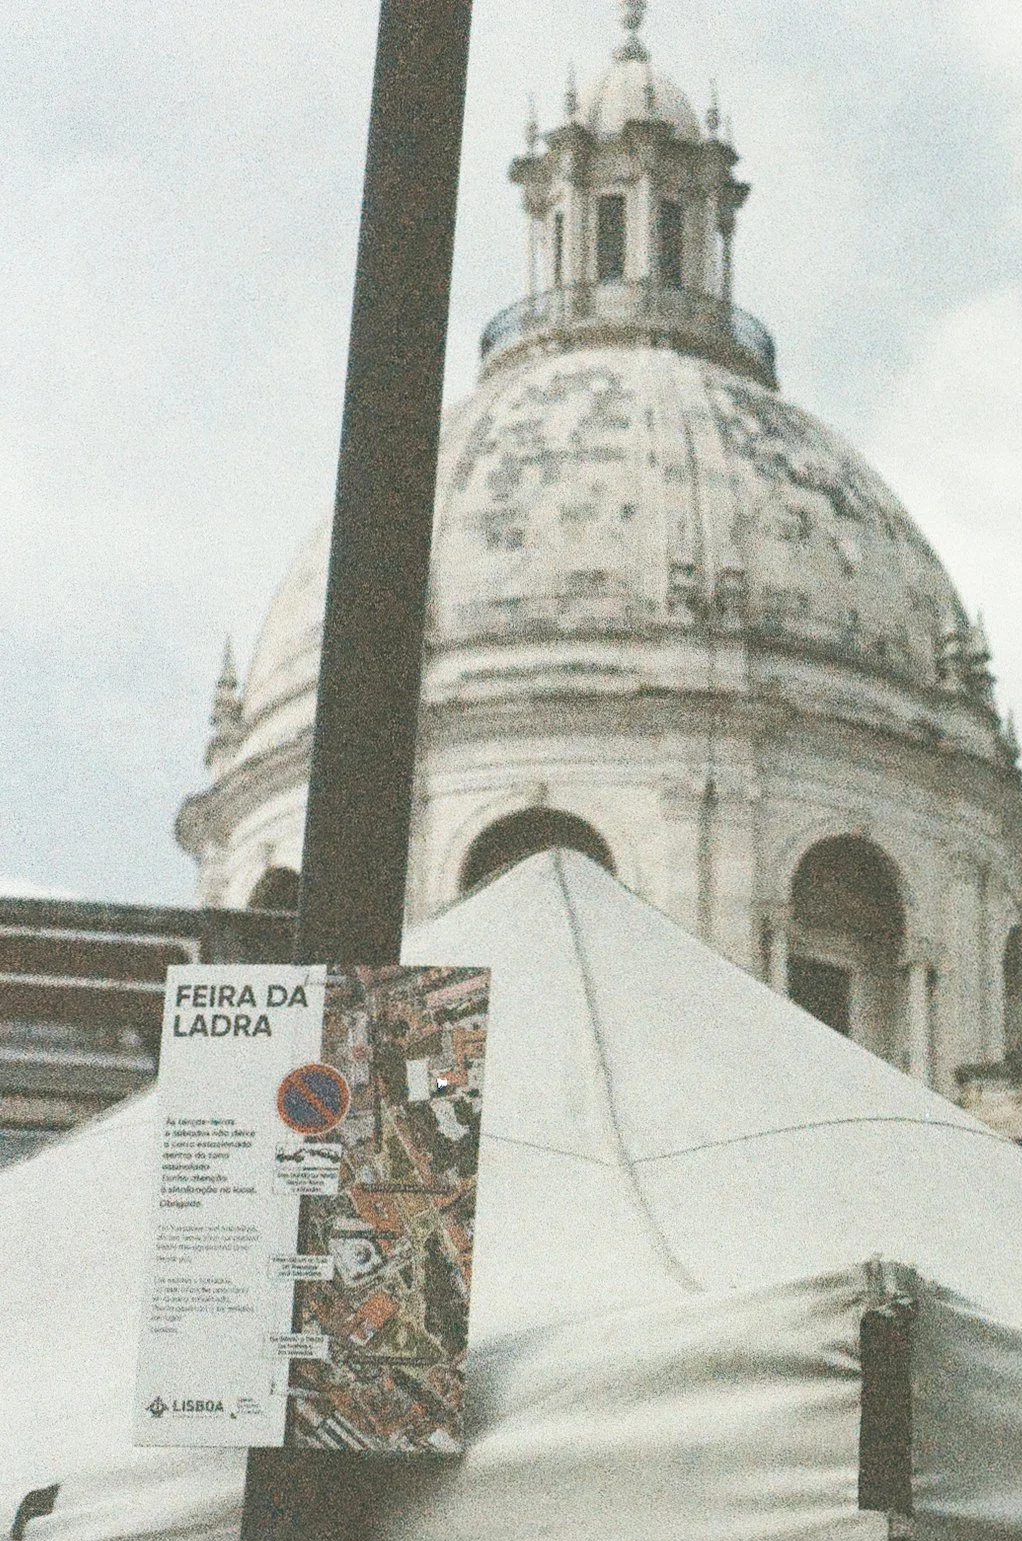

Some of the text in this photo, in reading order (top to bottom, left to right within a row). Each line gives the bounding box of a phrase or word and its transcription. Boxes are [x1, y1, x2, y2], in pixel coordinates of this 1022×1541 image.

[175, 984, 308, 1008] FEIRA DA
[173, 1014, 272, 1037] LADRA
[172, 1400, 224, 1412] LISBOA
